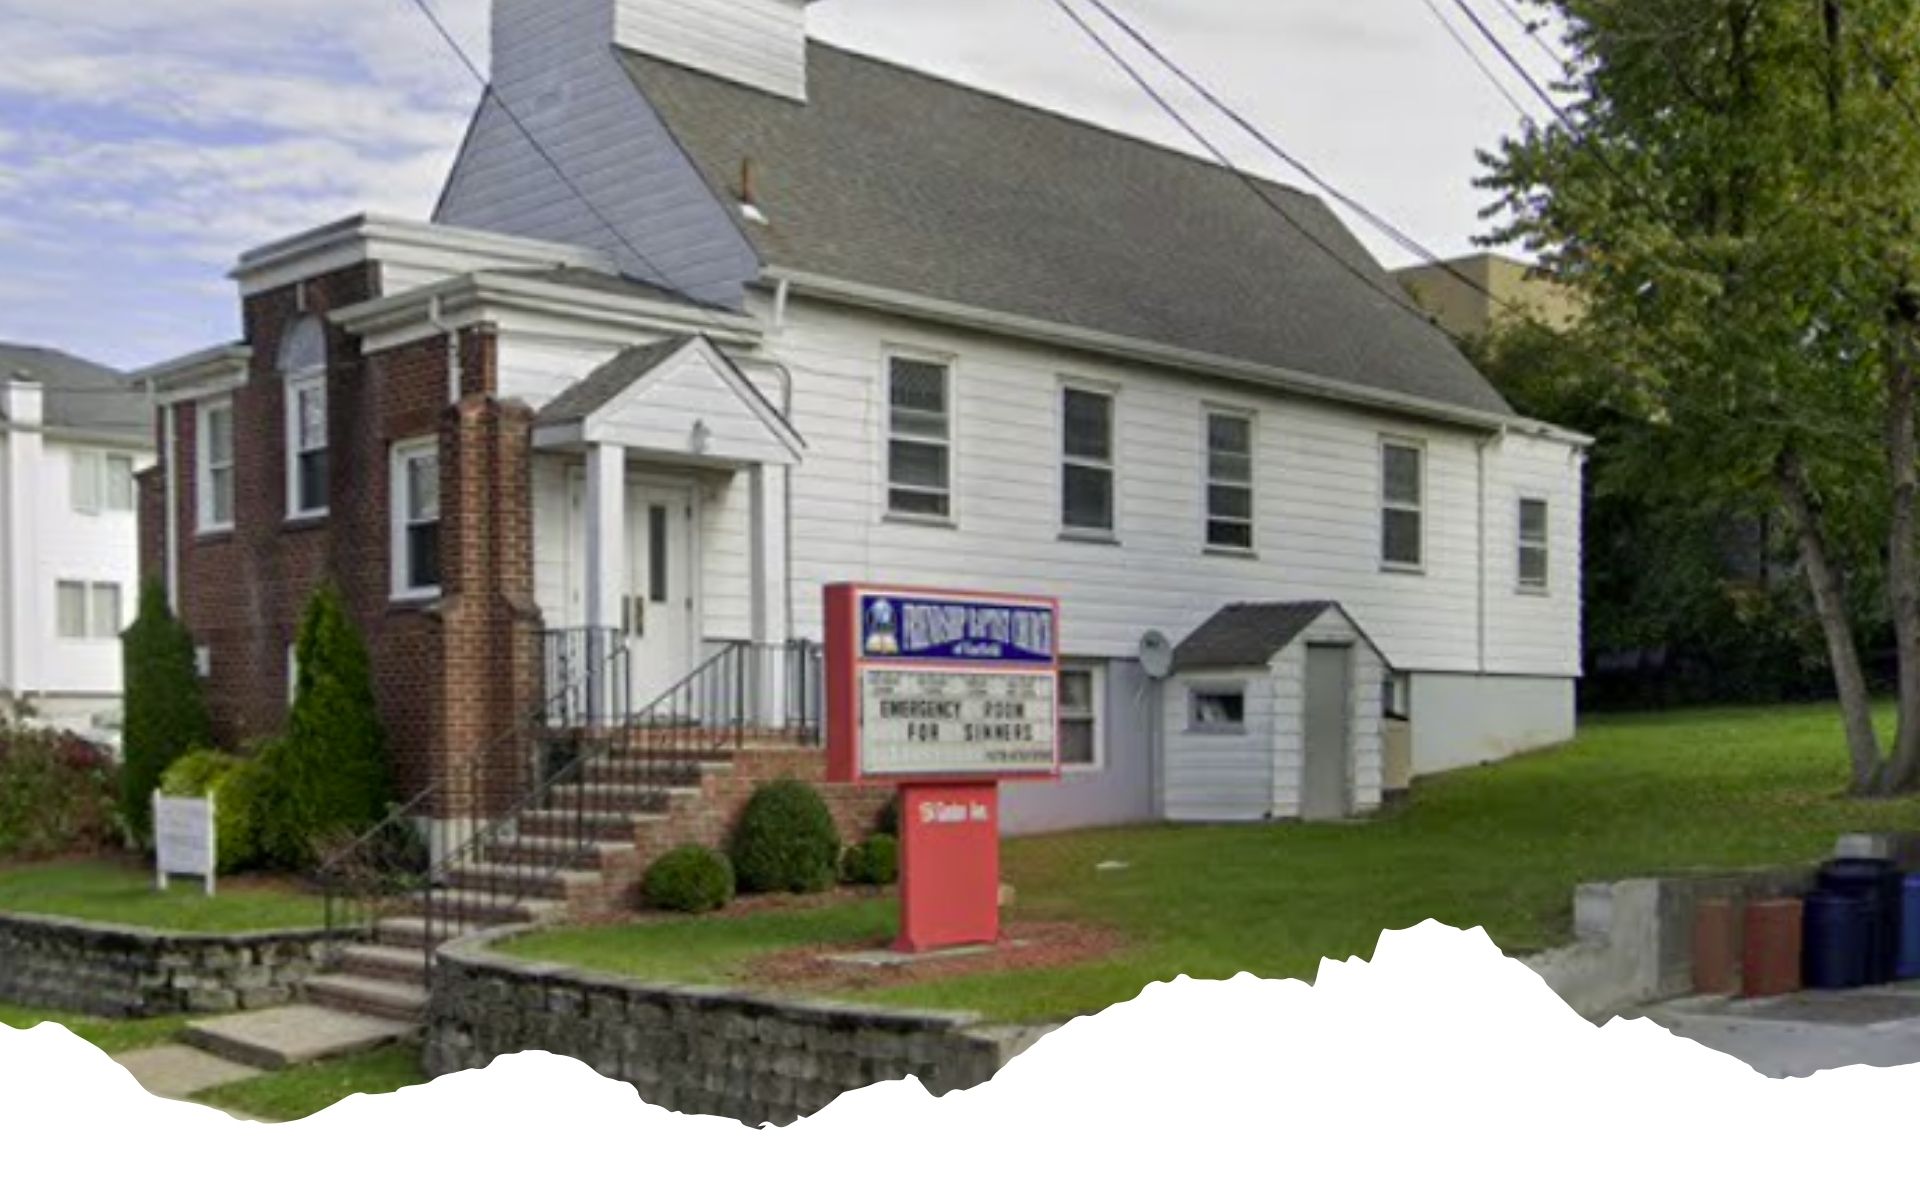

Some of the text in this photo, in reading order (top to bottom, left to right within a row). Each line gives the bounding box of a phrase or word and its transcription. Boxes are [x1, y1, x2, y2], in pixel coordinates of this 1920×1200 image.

[879, 700, 1024, 719] EMERGENCY ROOM
[907, 723, 1033, 742] FOR SINNERS
